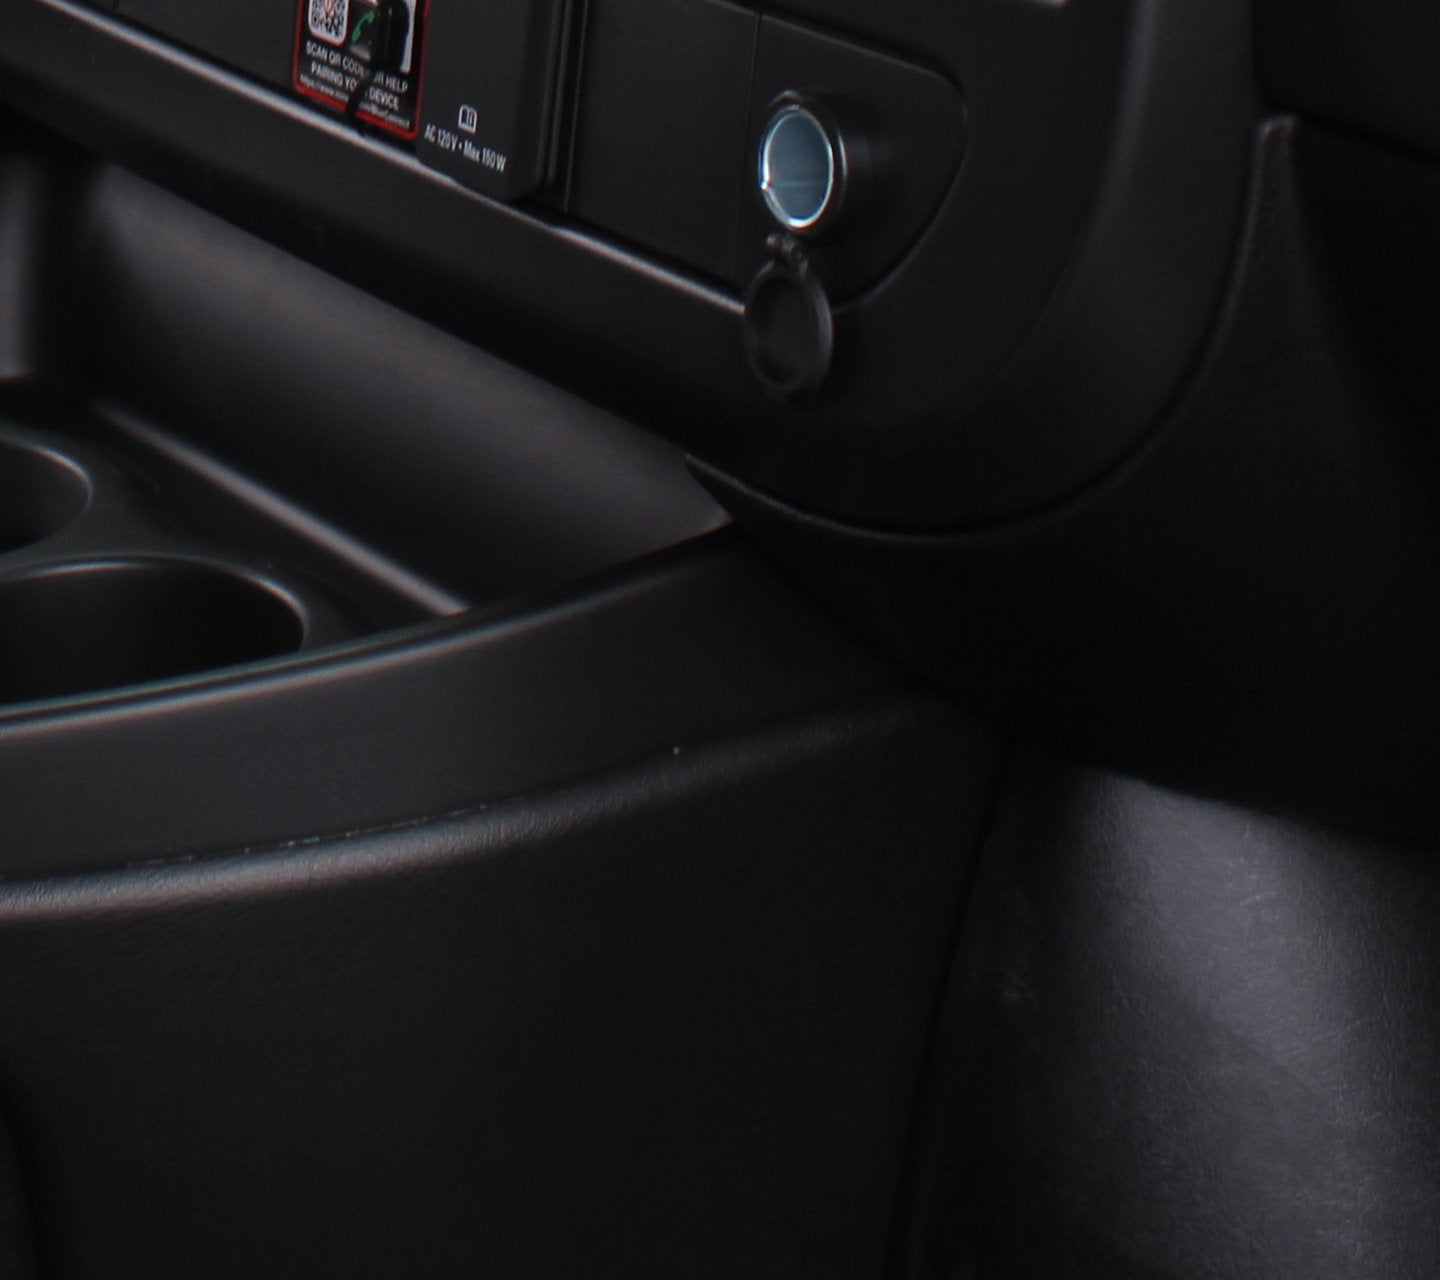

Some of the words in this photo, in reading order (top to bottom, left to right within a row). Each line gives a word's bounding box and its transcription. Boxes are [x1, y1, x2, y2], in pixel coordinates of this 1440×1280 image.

[306, 40, 328, 62] SCAN
[329, 50, 341, 67] QR
[386, 74, 408, 93] HELP
[311, 60, 343, 87] PAIRING
[369, 86, 399, 111] DEVICE
[424, 123, 436, 143] AC
[463, 139, 480, 162] Max
